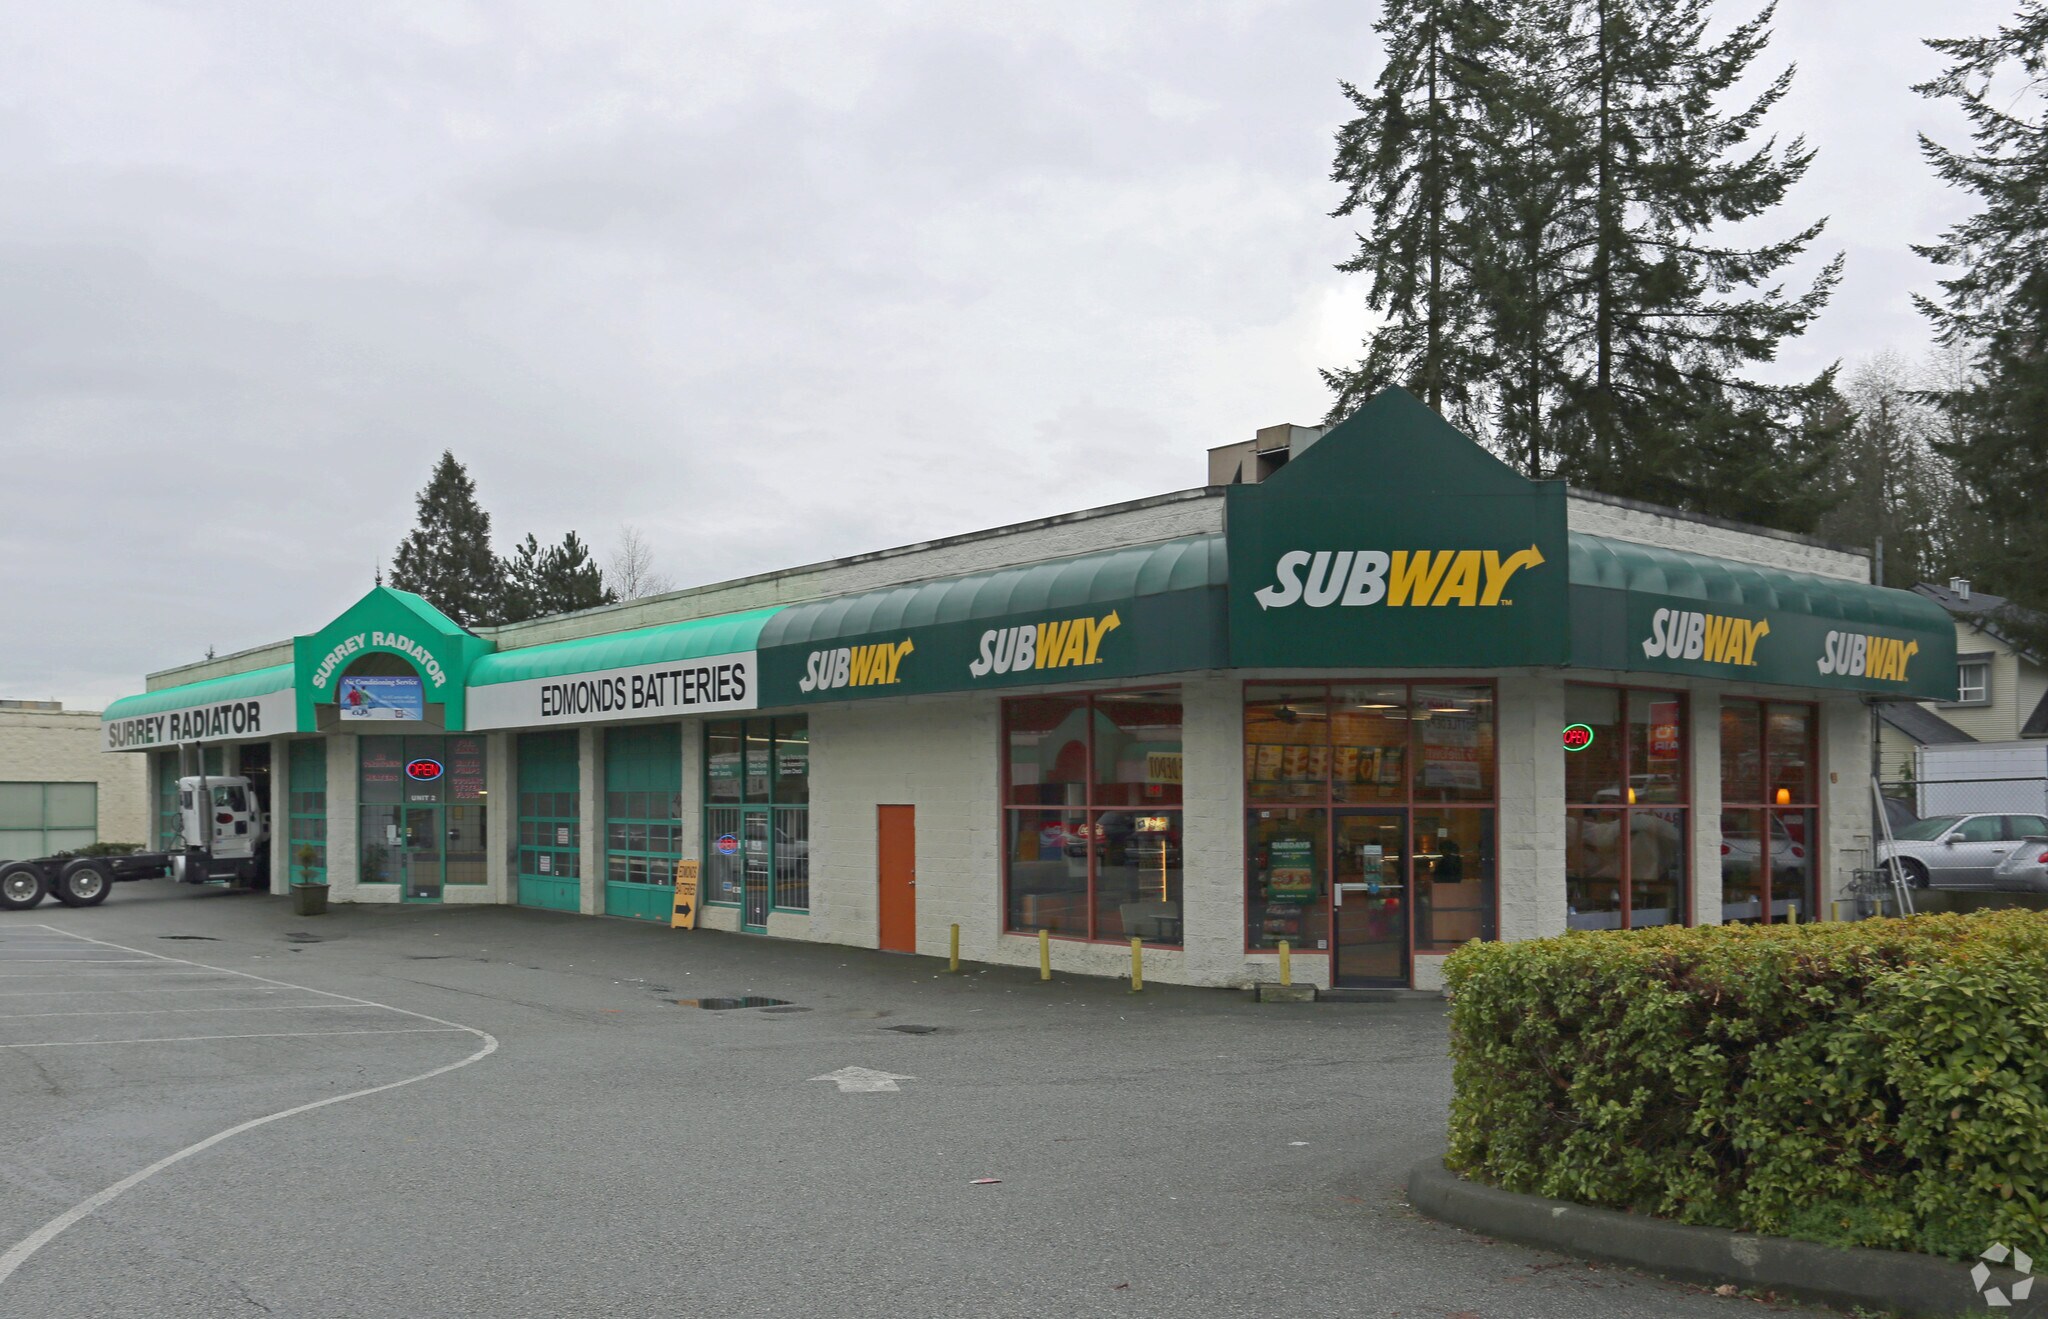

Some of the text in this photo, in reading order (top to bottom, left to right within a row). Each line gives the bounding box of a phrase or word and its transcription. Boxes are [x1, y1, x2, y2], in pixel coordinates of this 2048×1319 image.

[1254, 543, 1545, 611] SUBWAY
[312, 631, 446, 689] SURREY RADIATOR
[969, 609, 1121, 679] SUBWAY
[1642, 608, 1770, 666] SUBWAY
[1817, 630, 1919, 682] SUBWAY
[355, 678, 396, 687] Conditioning
[396, 678, 418, 686] Service
[541, 663, 746, 717] EDMONDS BATTERIES
[799, 636, 915, 693] SUBWAY
[108, 701, 261, 748] SURREY RADIATOR
[1563, 730, 1588, 743] OPEN
[408, 763, 440, 776] OPEN
